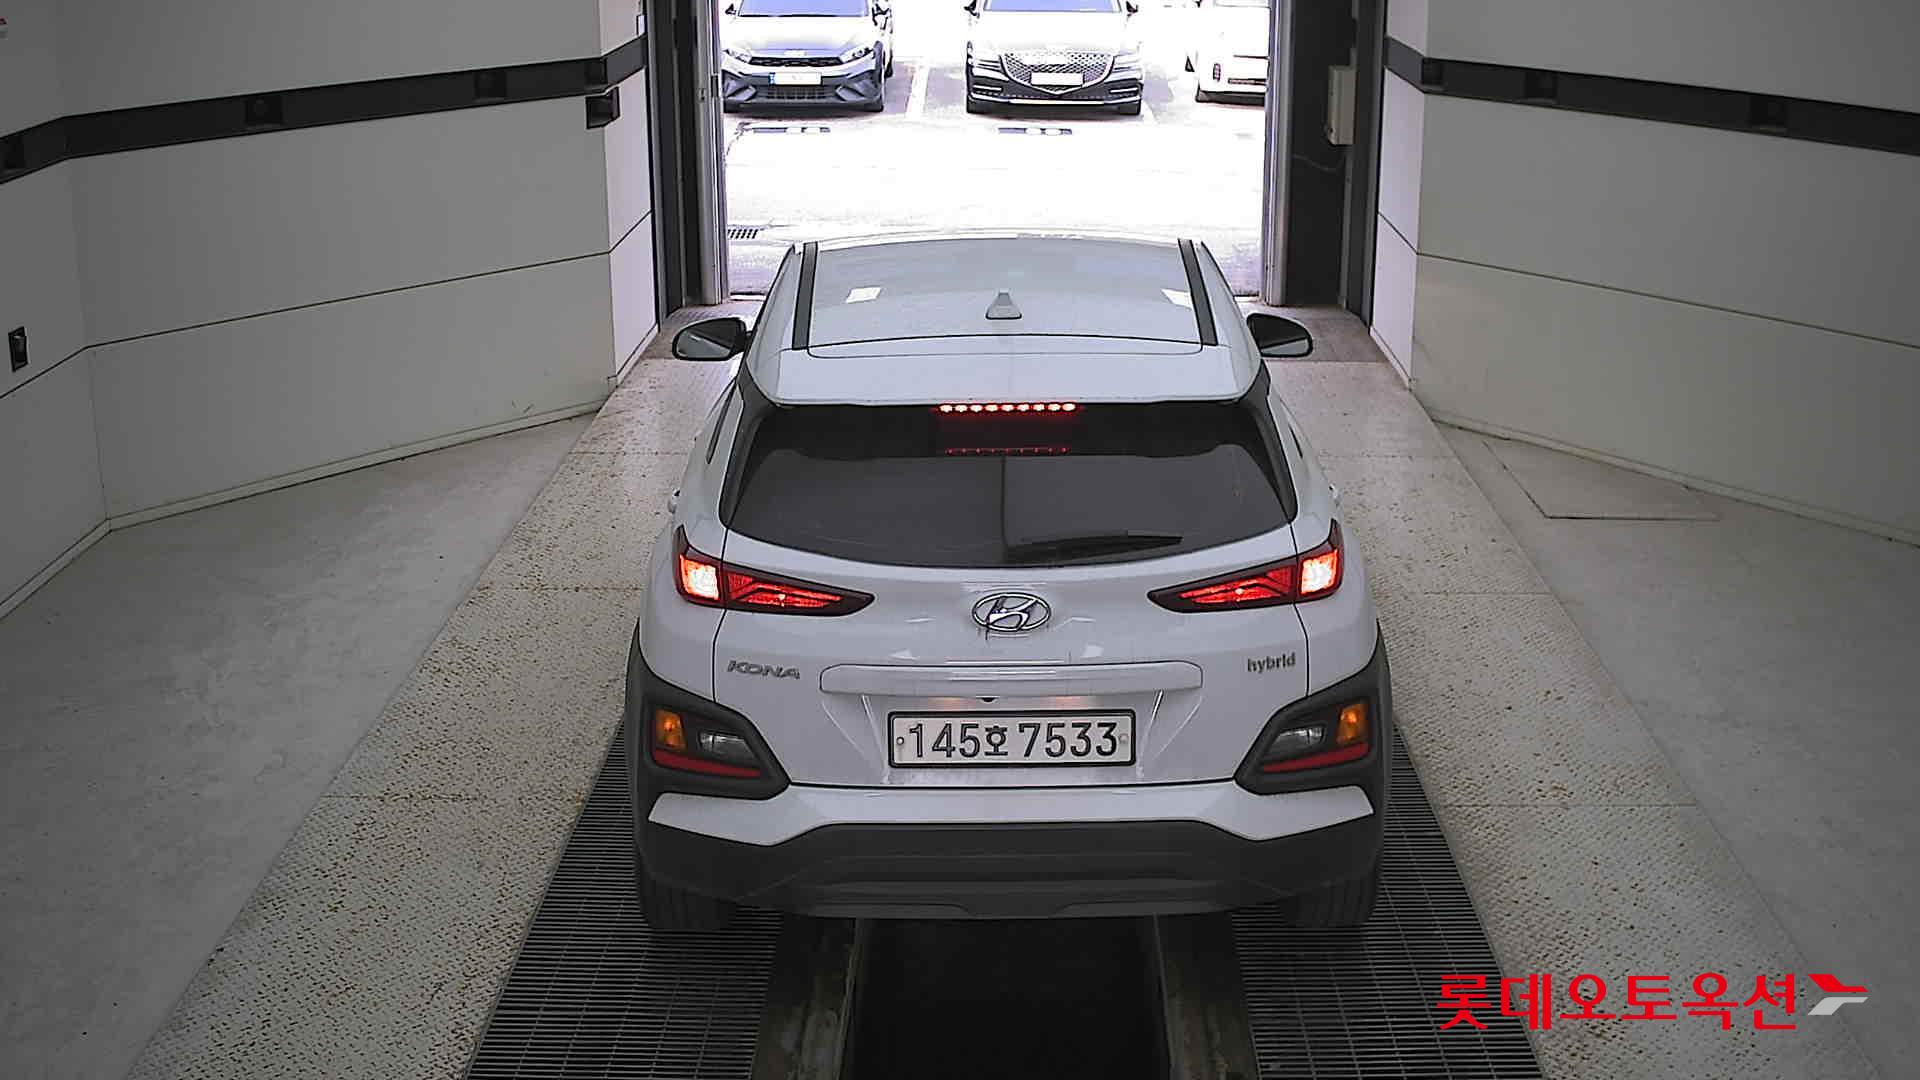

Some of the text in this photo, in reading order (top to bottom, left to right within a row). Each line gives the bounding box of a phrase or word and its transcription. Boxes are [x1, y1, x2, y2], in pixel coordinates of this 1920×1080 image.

[727, 660, 801, 680] KONA
[1247, 652, 1296, 674] hybrid
[1018, 721, 1118, 758] 7533
